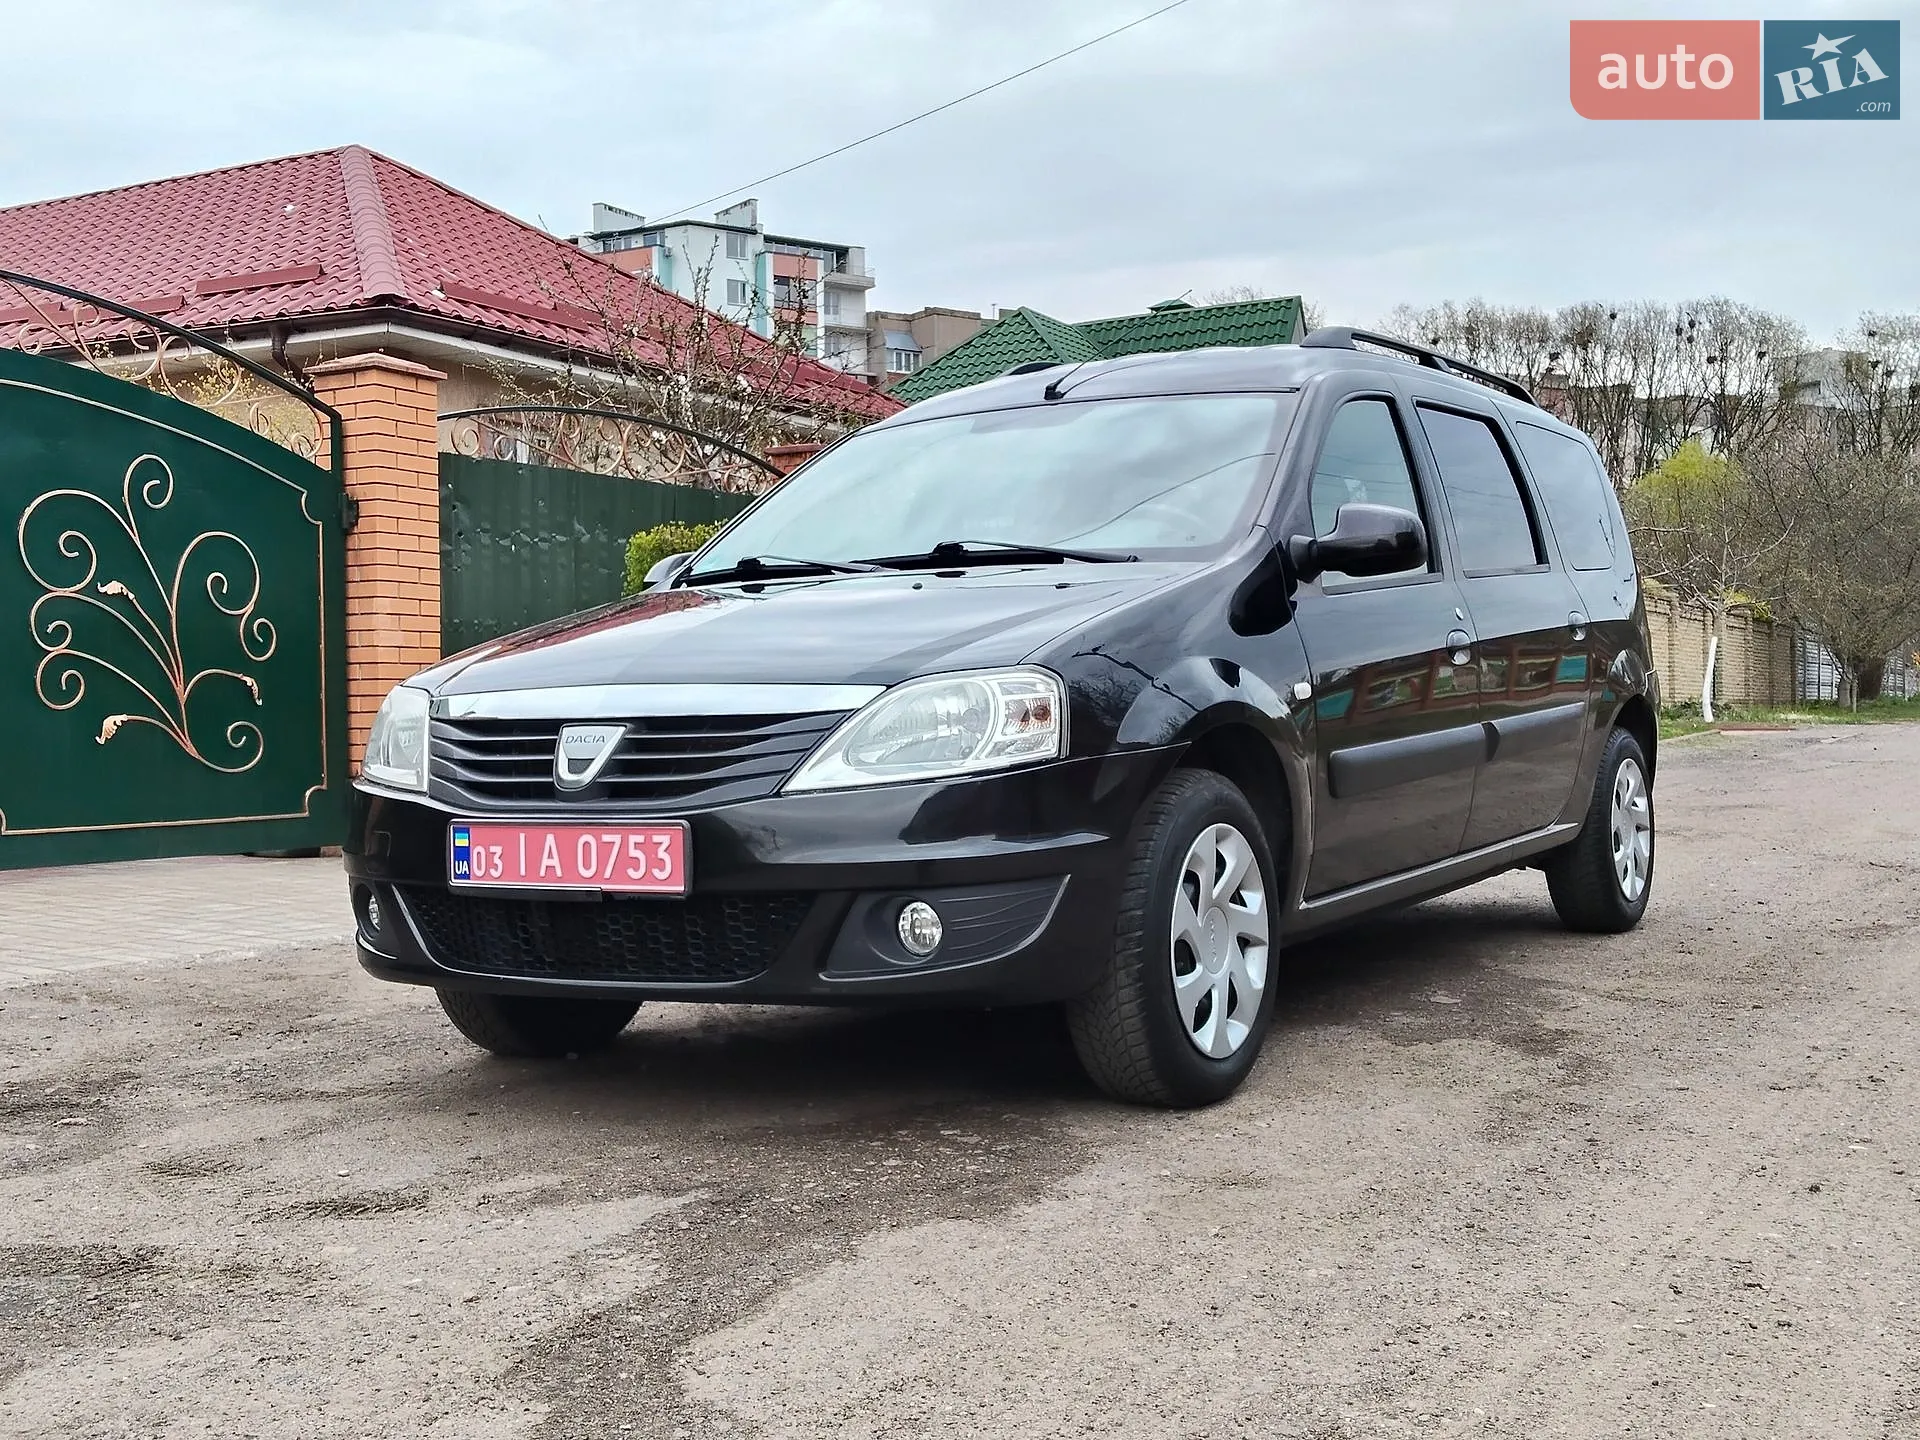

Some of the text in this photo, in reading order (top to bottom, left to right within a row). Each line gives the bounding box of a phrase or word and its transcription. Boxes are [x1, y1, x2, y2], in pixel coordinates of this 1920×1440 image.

[565, 735, 606, 744] DACIA
[455, 860, 470, 875] UA
[472, 845, 504, 878] 03
